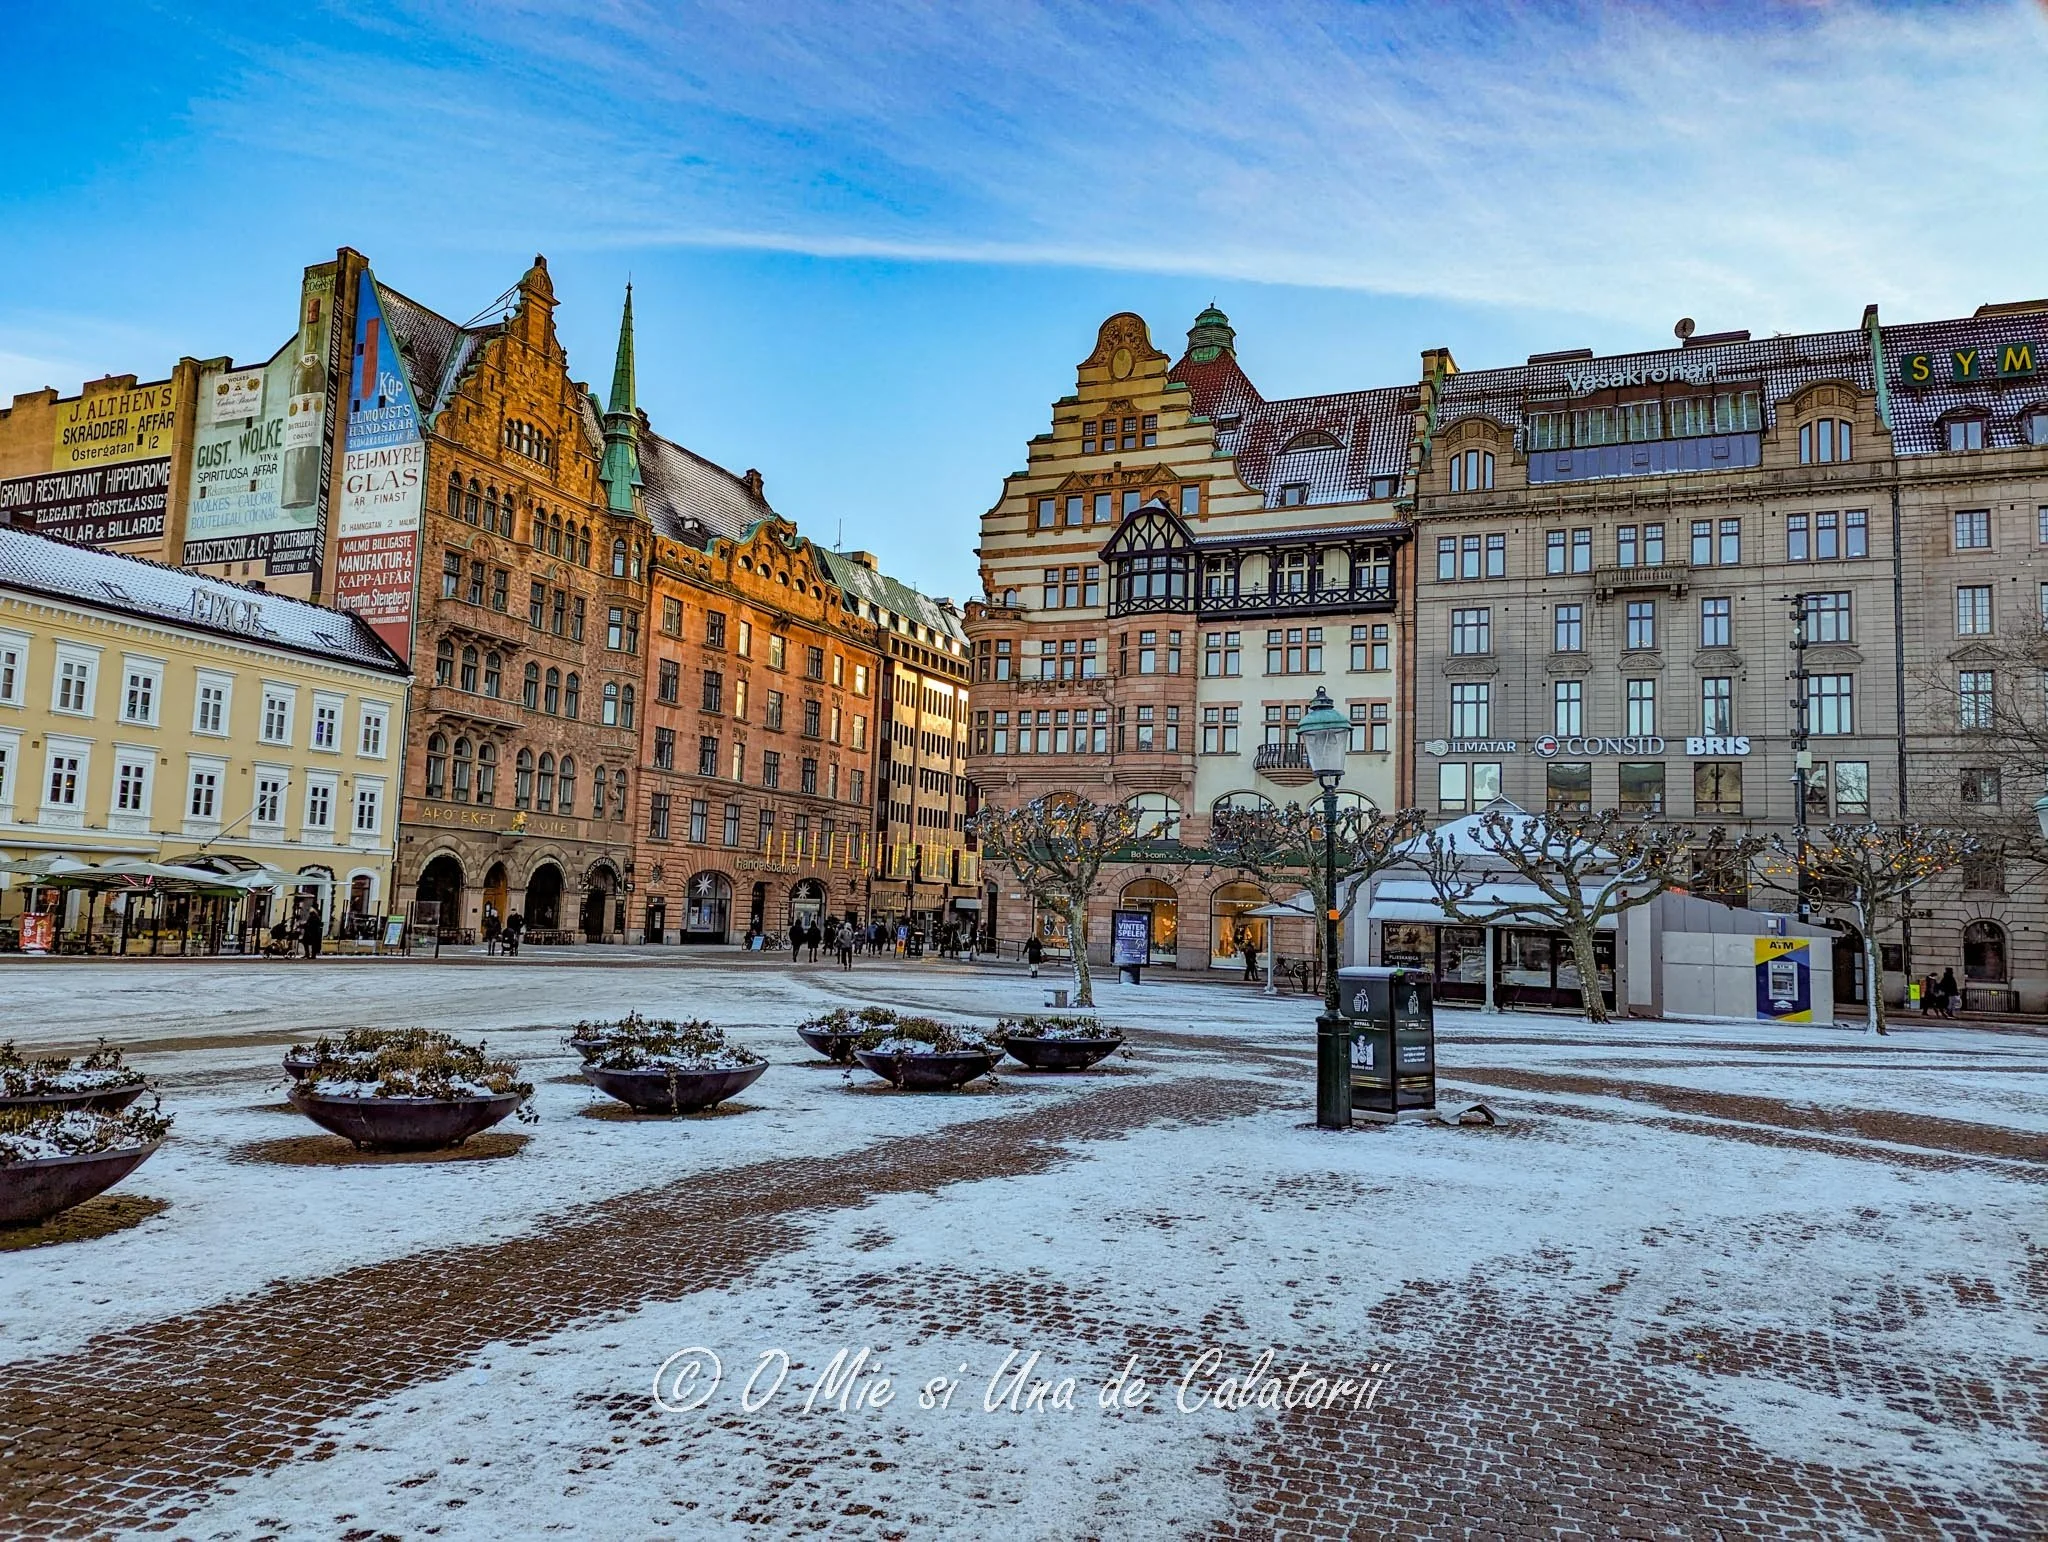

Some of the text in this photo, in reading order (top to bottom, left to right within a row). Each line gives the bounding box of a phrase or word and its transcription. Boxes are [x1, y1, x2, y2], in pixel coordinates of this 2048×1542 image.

[1565, 361, 1717, 392] Vasakronan
[379, 372, 403, 403] KÖP
[70, 403, 82, 422] J.
[63, 411, 175, 445] SKRÄDDERI AFFÄR
[72, 436, 159, 461] Östergatan 12
[197, 418, 283, 468] GUST. WOLKE
[347, 446, 422, 471] REIJMYRE
[197, 467, 248, 483] SPIRITUOSA
[346, 468, 417, 493] GLAS
[1, 462, 170, 508] GRAND RESTAURANT HIPPODROME
[193, 497, 230, 513] WOLKES
[96, 526, 106, 539] &
[108, 515, 165, 537] BILLARDE
[387, 520, 392, 528] 2
[184, 537, 246, 564] CHRISTENSON
[247, 540, 255, 558] &
[273, 530, 316, 550] SKYLTFABRIK
[372, 535, 411, 550] BILLIGASTE
[306, 547, 312, 559] 4
[272, 564, 294, 573] TELEFON
[337, 588, 410, 609] Florentin Steneberg
[1452, 741, 1516, 753] ILMATAR
[1567, 737, 1664, 755] CONSID
[1686, 736, 1750, 756] BRIS
[735, 856, 801, 874] Handelsbanken
[1043, 924, 1070, 937] SAL
[1118, 930, 1146, 938] SPELEN
[1769, 942, 1794, 950] ATM
